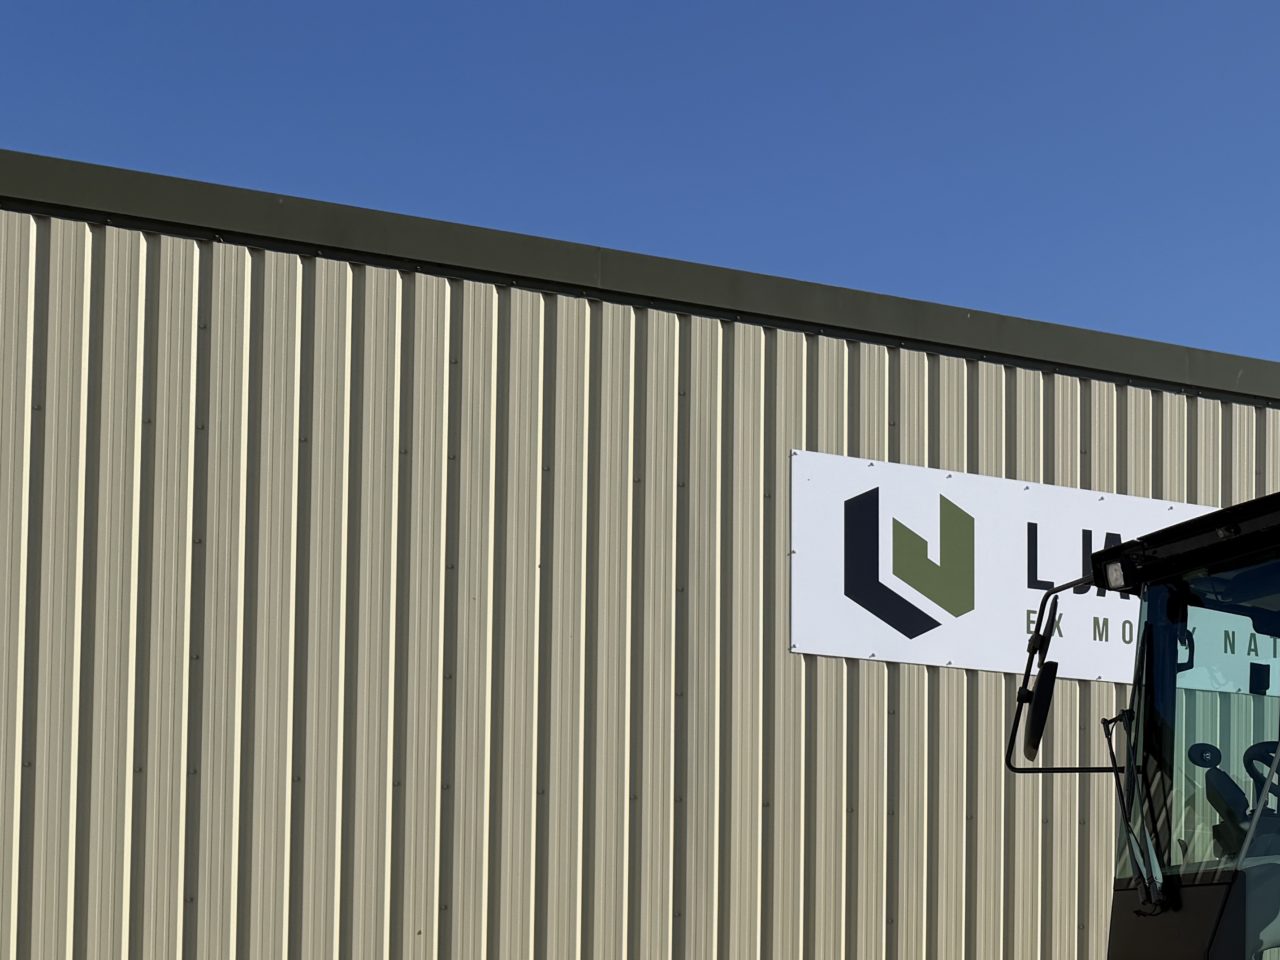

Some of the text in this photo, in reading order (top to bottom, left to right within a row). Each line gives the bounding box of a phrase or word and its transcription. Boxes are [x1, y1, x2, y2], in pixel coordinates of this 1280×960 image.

[1027, 522, 1054, 591] L
[1092, 616, 1134, 645] MO
[1223, 629, 1280, 659] NAT
